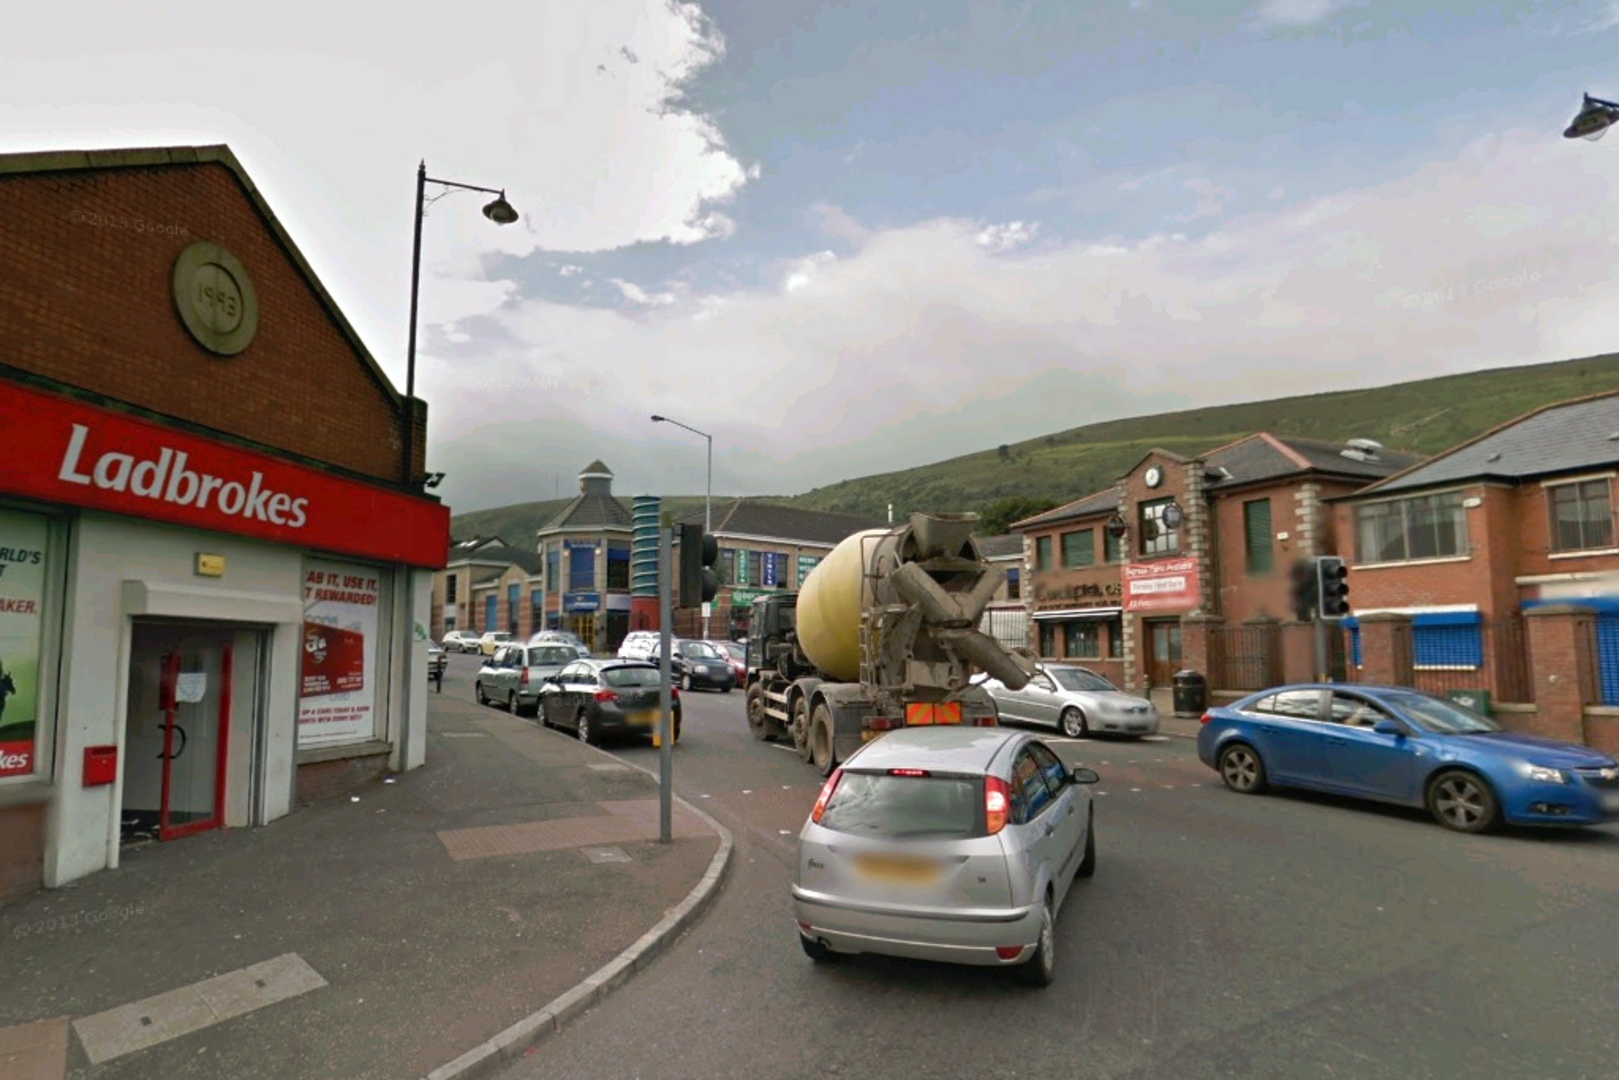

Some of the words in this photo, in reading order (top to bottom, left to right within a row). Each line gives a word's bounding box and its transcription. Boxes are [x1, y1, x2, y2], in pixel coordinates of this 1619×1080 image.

[58, 423, 309, 528] Ladbrokes
[342, 575, 364, 590] USE
[314, 588, 377, 606] REWARDED!
